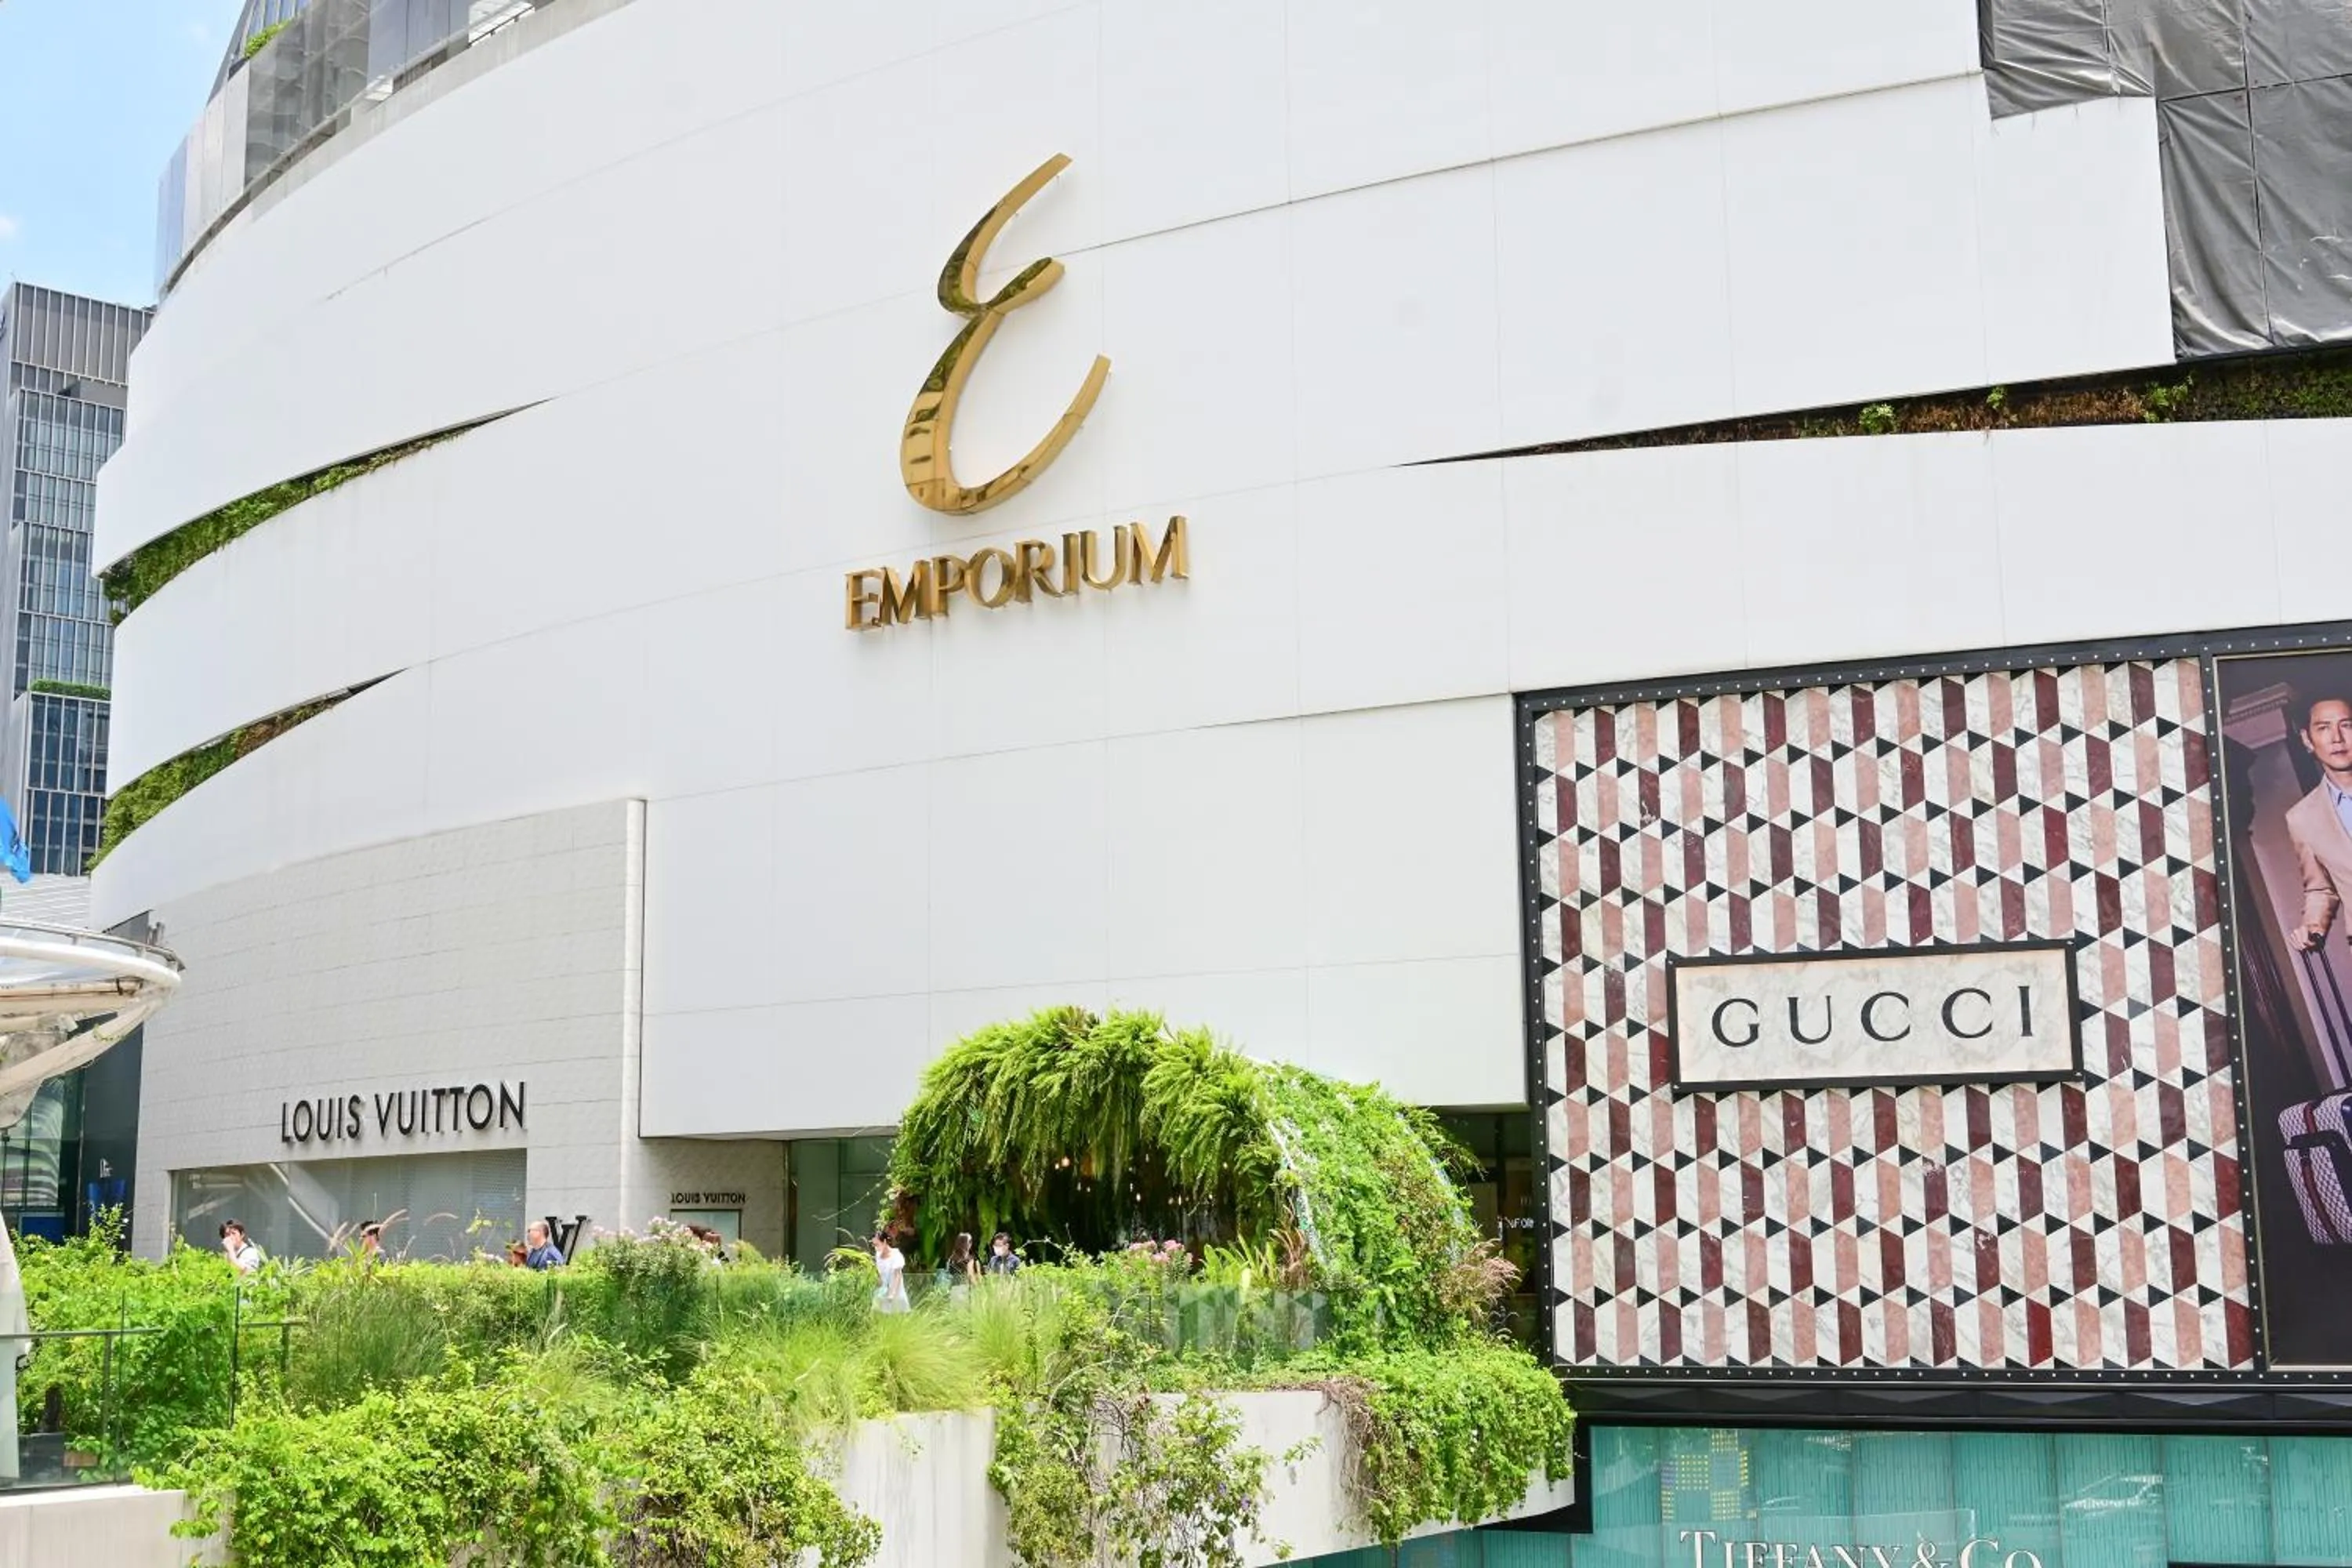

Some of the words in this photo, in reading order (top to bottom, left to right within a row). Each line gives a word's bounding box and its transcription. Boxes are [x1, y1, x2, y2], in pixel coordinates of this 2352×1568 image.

[845, 515, 1189, 630] EMPORIUM
[1711, 985, 2034, 1048] GUCCI
[281, 1094, 363, 1143] LOUIS
[374, 1080, 526, 1137] VUITTON
[670, 1192, 701, 1204] LOUIS
[702, 1191, 746, 1205] VUITTON
[1680, 1530, 1902, 1568] TIFFANY
[1911, 1541, 1951, 1568] &
